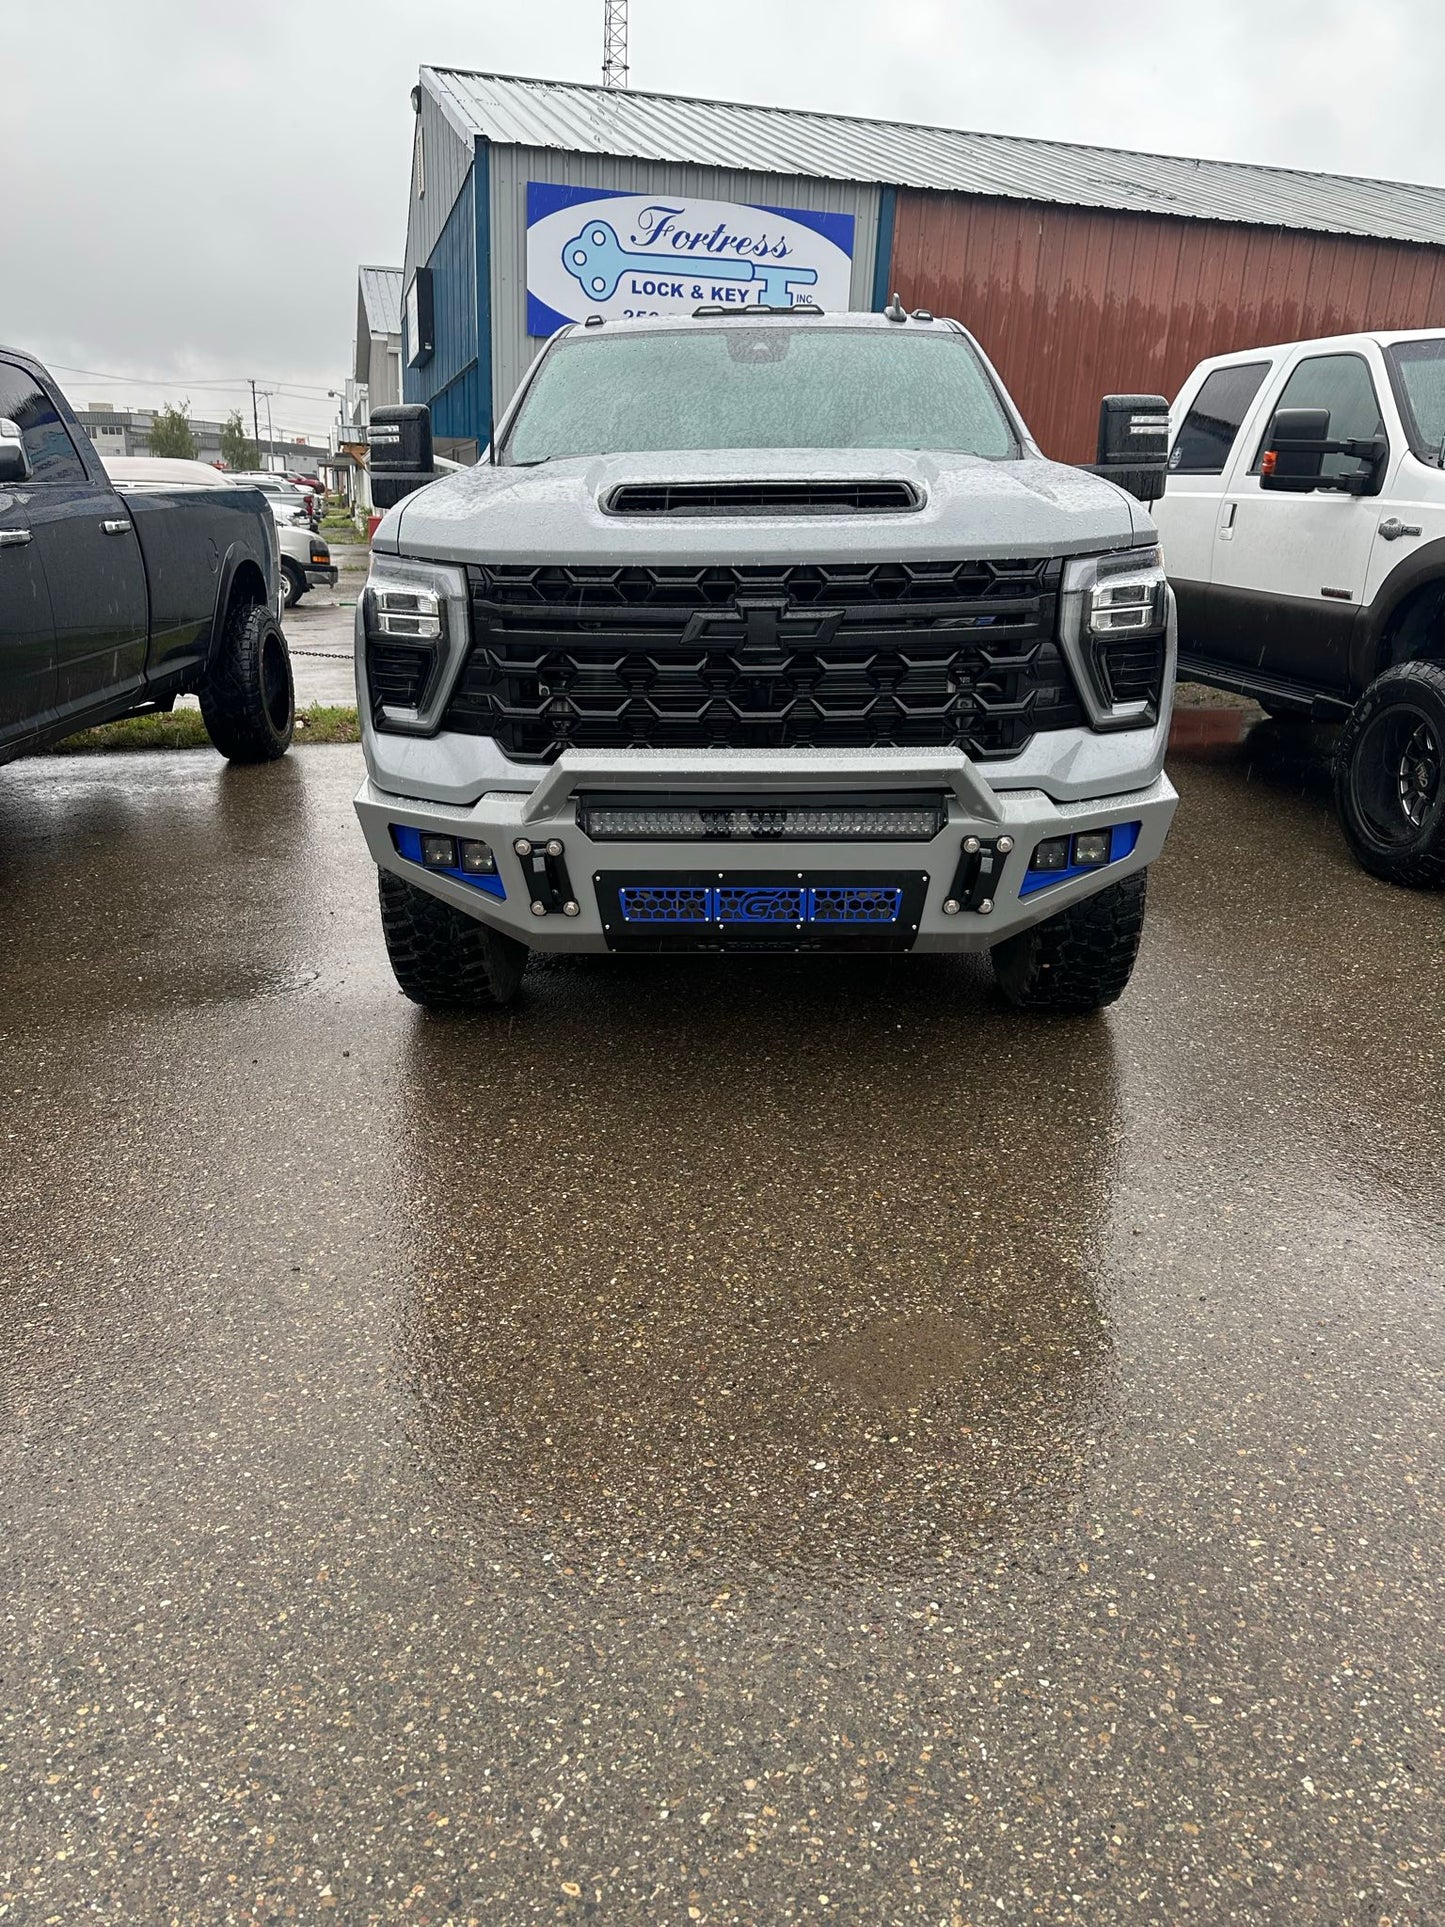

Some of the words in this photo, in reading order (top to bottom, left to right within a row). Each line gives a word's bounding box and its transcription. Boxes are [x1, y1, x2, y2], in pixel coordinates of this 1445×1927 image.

[630, 205, 793, 258] Fortress
[631, 280, 684, 298] LOCK
[691, 285, 704, 300] &
[711, 286, 749, 303] KEY
[796, 294, 813, 304] INC
